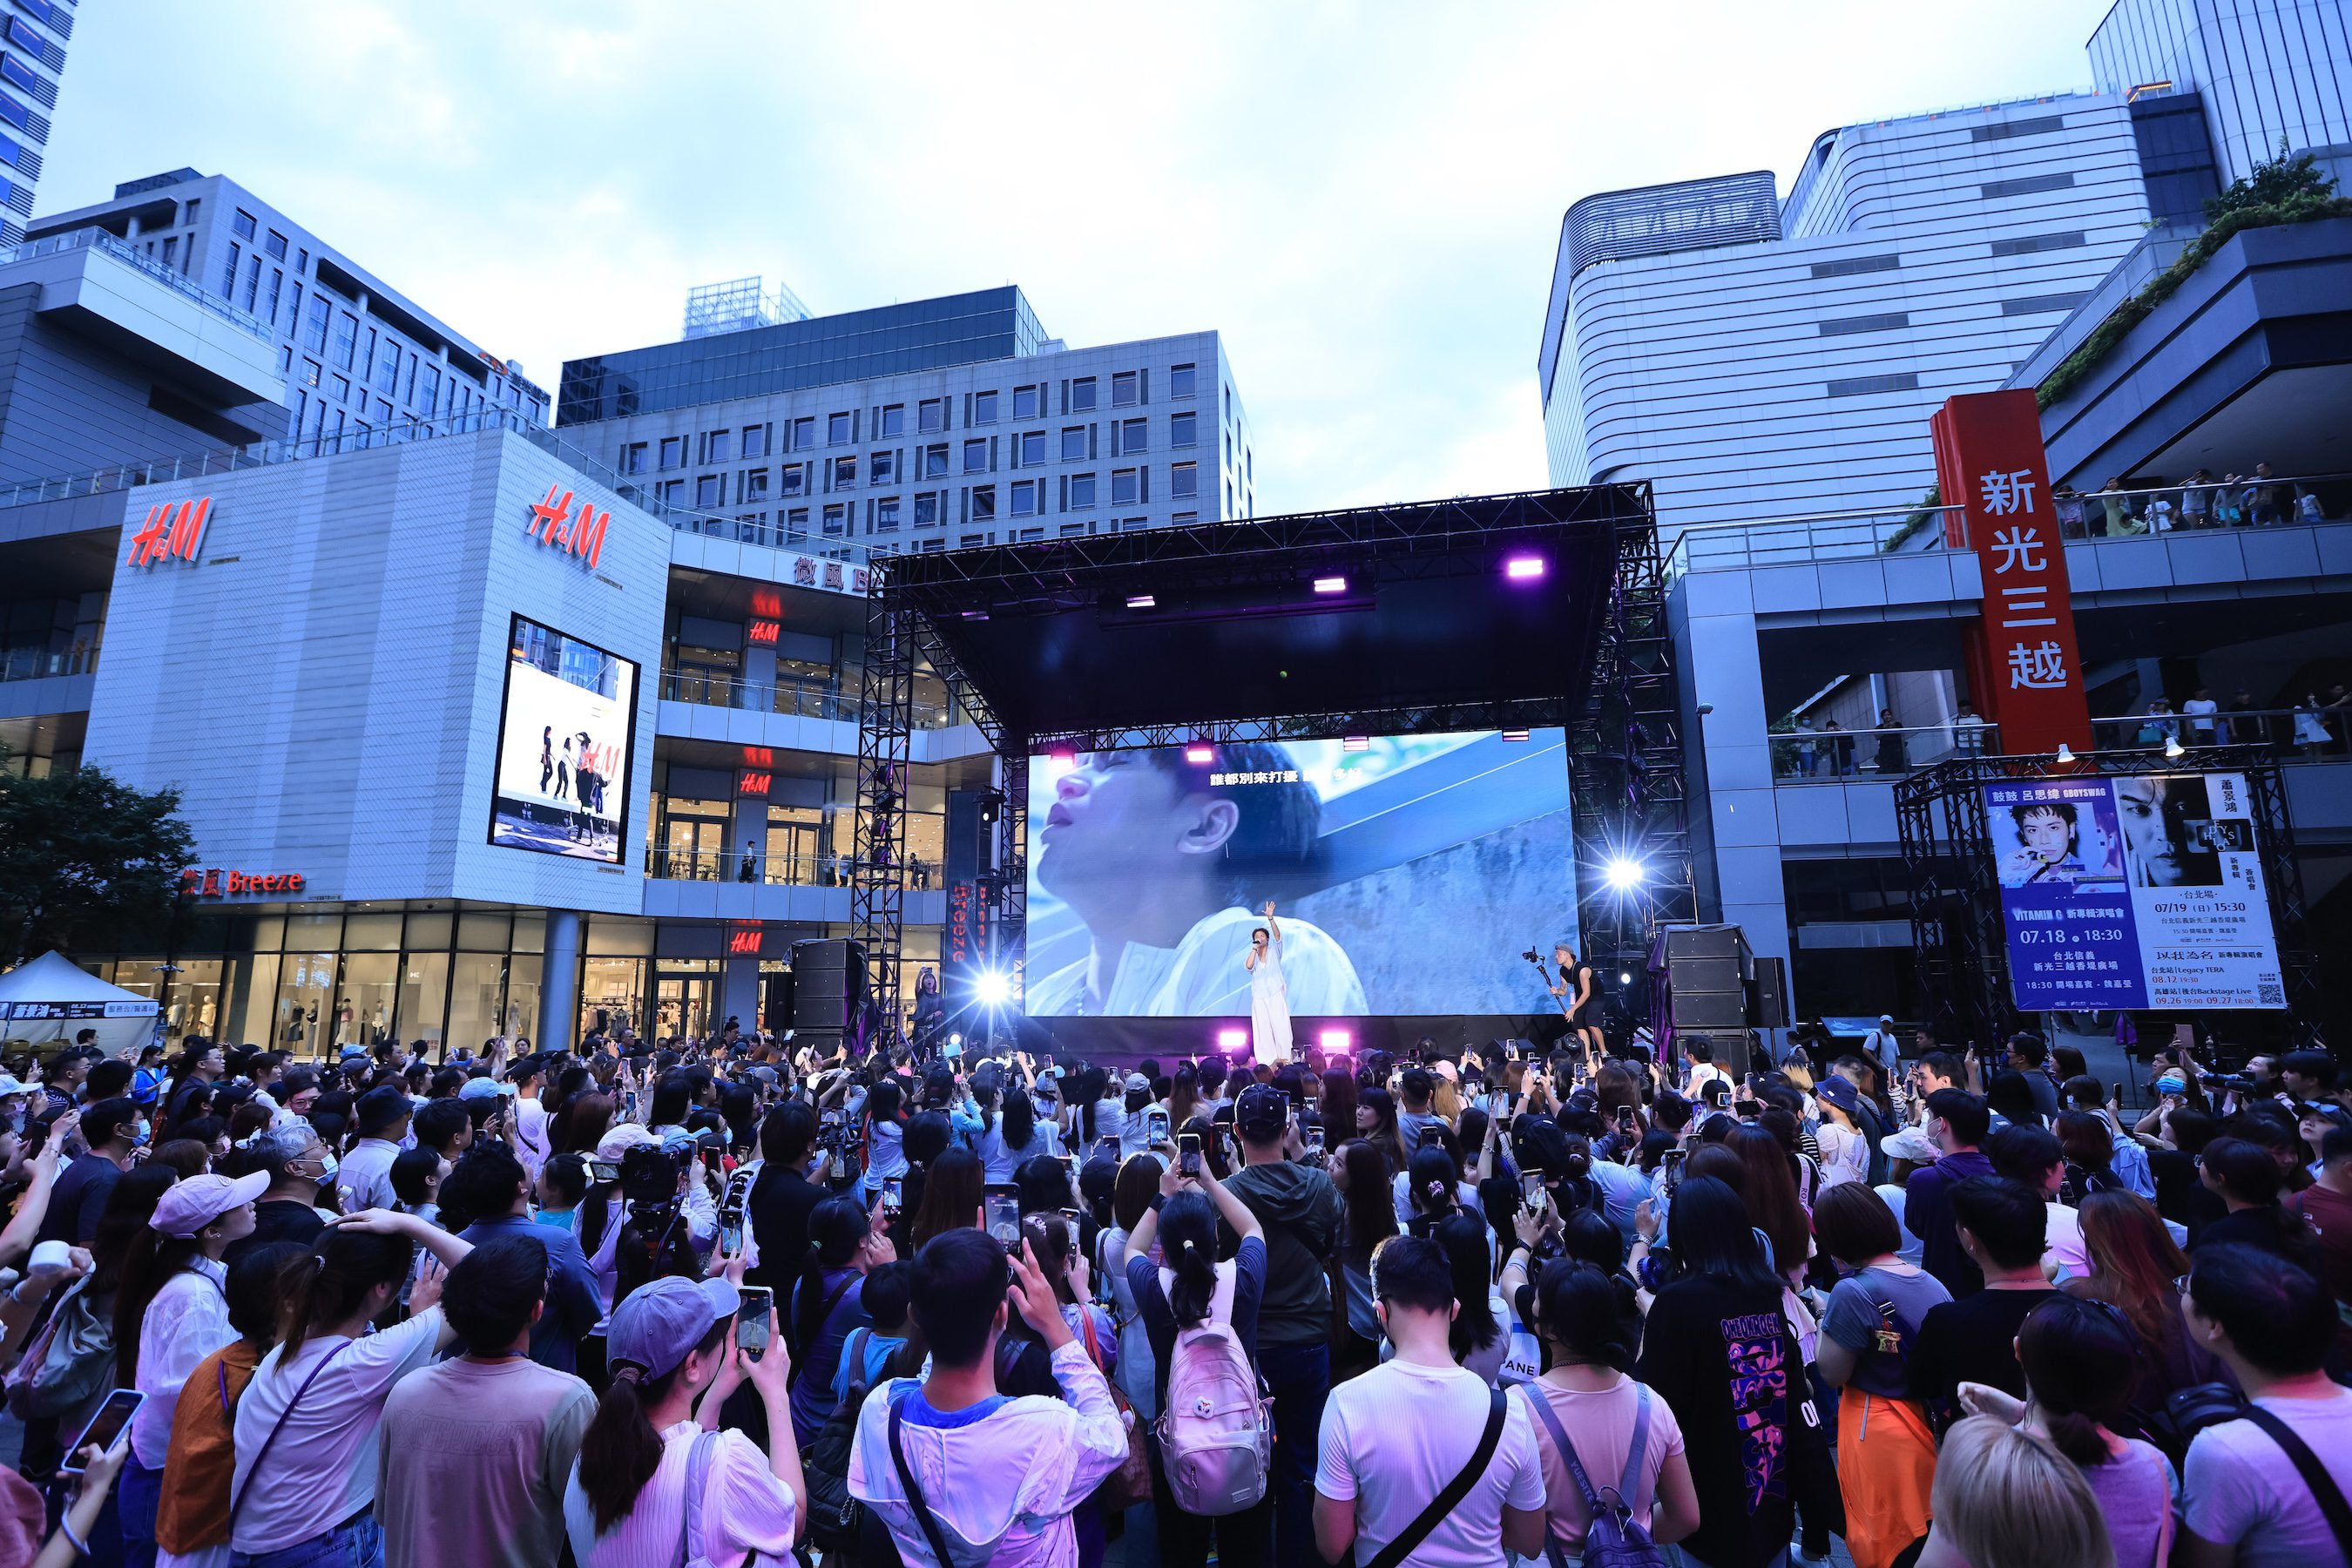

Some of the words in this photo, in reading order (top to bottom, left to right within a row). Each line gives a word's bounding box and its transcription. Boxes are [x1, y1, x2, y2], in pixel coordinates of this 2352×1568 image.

[127, 496, 212, 567] H&M
[530, 483, 611, 569] H&M
[794, 556, 844, 592] 微風
[1980, 468, 2067, 690] 新光三越
[749, 621, 781, 642] H&M
[740, 773, 772, 794] H&M
[1992, 791, 2018, 802] 鼓鼓
[2063, 787, 2106, 798] GBOYSWAG
[227, 870, 304, 893] Breeze
[2012, 908, 2053, 922] VITAMIN
[2154, 903, 2186, 912] 07/19
[2214, 902, 2246, 911] 15:30
[731, 931, 762, 953] H&M
[2019, 929, 2066, 943] 07.18
[2084, 929, 2123, 941] 18:30
[2033, 961, 2119, 971] 新光三越香堤廣場
[2053, 951, 2096, 961] 台北信義
[2157, 951, 2213, 960] 以我為名
[1571, 1460, 1595, 1504] YUESITE
